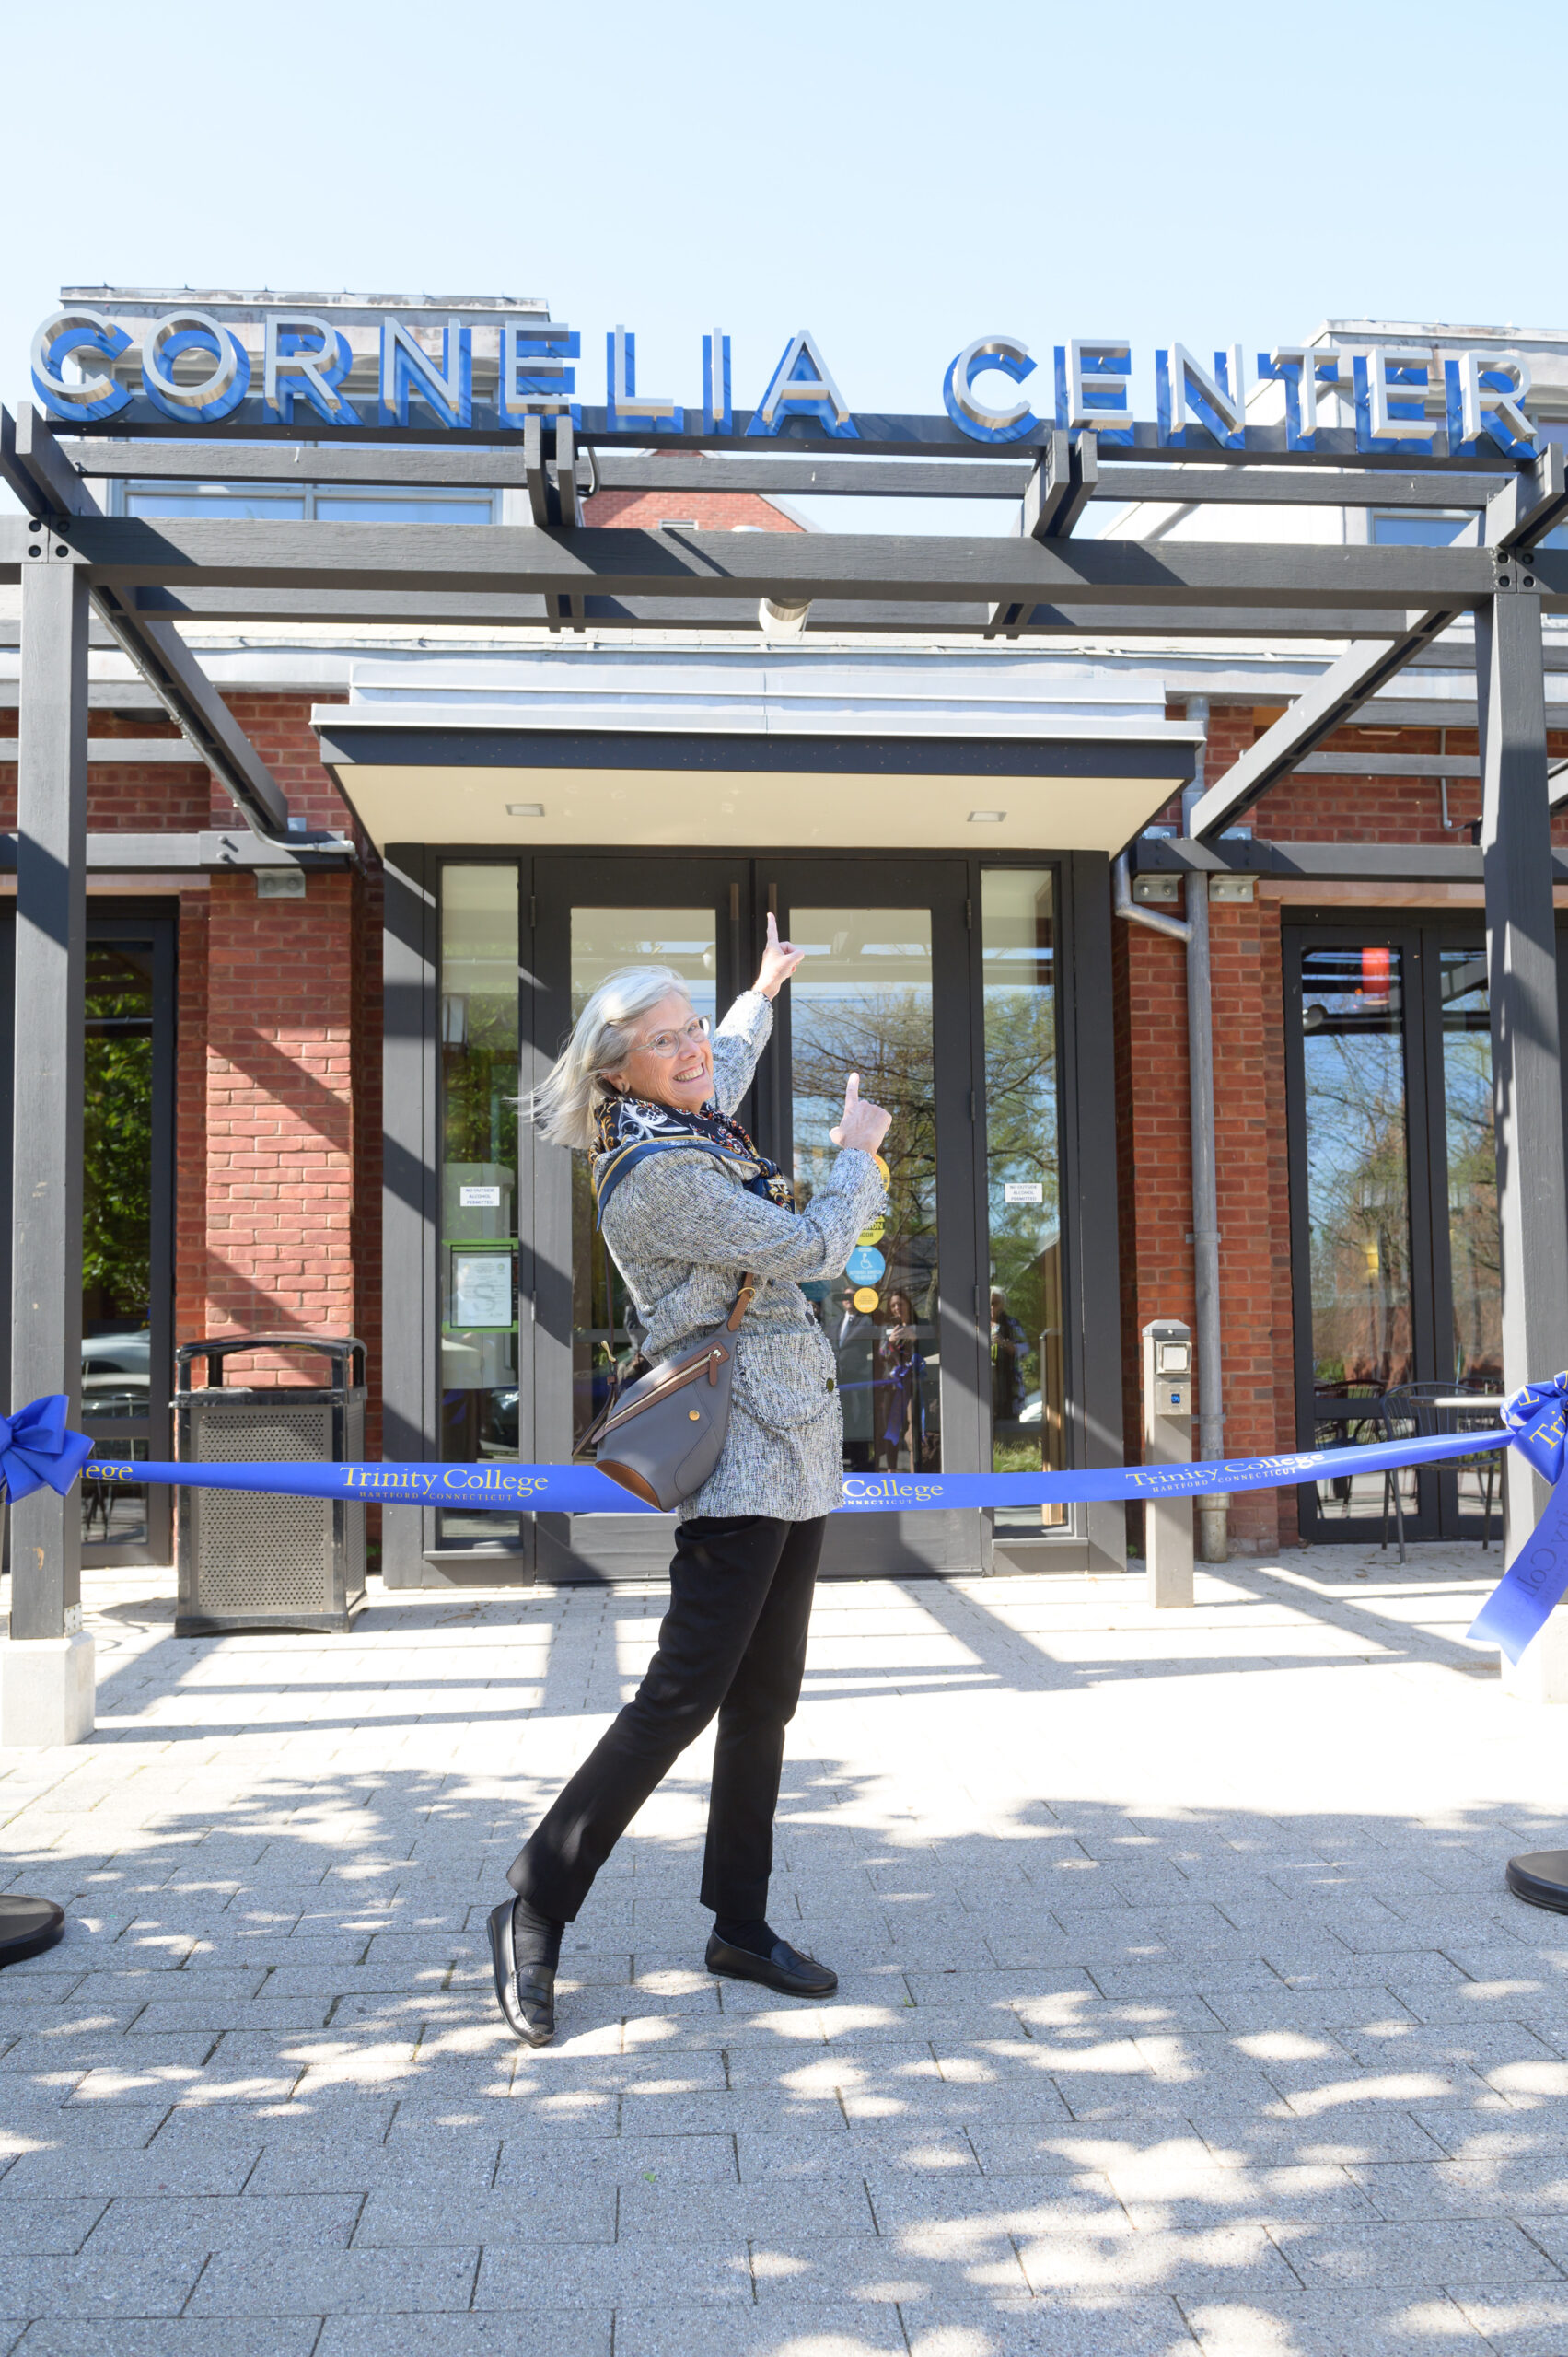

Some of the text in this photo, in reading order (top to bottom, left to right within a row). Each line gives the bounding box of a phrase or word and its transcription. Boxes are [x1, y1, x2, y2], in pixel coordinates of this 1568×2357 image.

[30, 308, 1538, 458] CORNELIA CENTER
[340, 1467, 549, 1497] Trinity College
[1125, 1454, 1325, 1487] Trinity College
[1153, 1468, 1296, 1493] HARTFORD CONNECTICUT
[359, 1491, 513, 1502] HARTFORD CONNECTICUT
[842, 1479, 944, 1502] College
